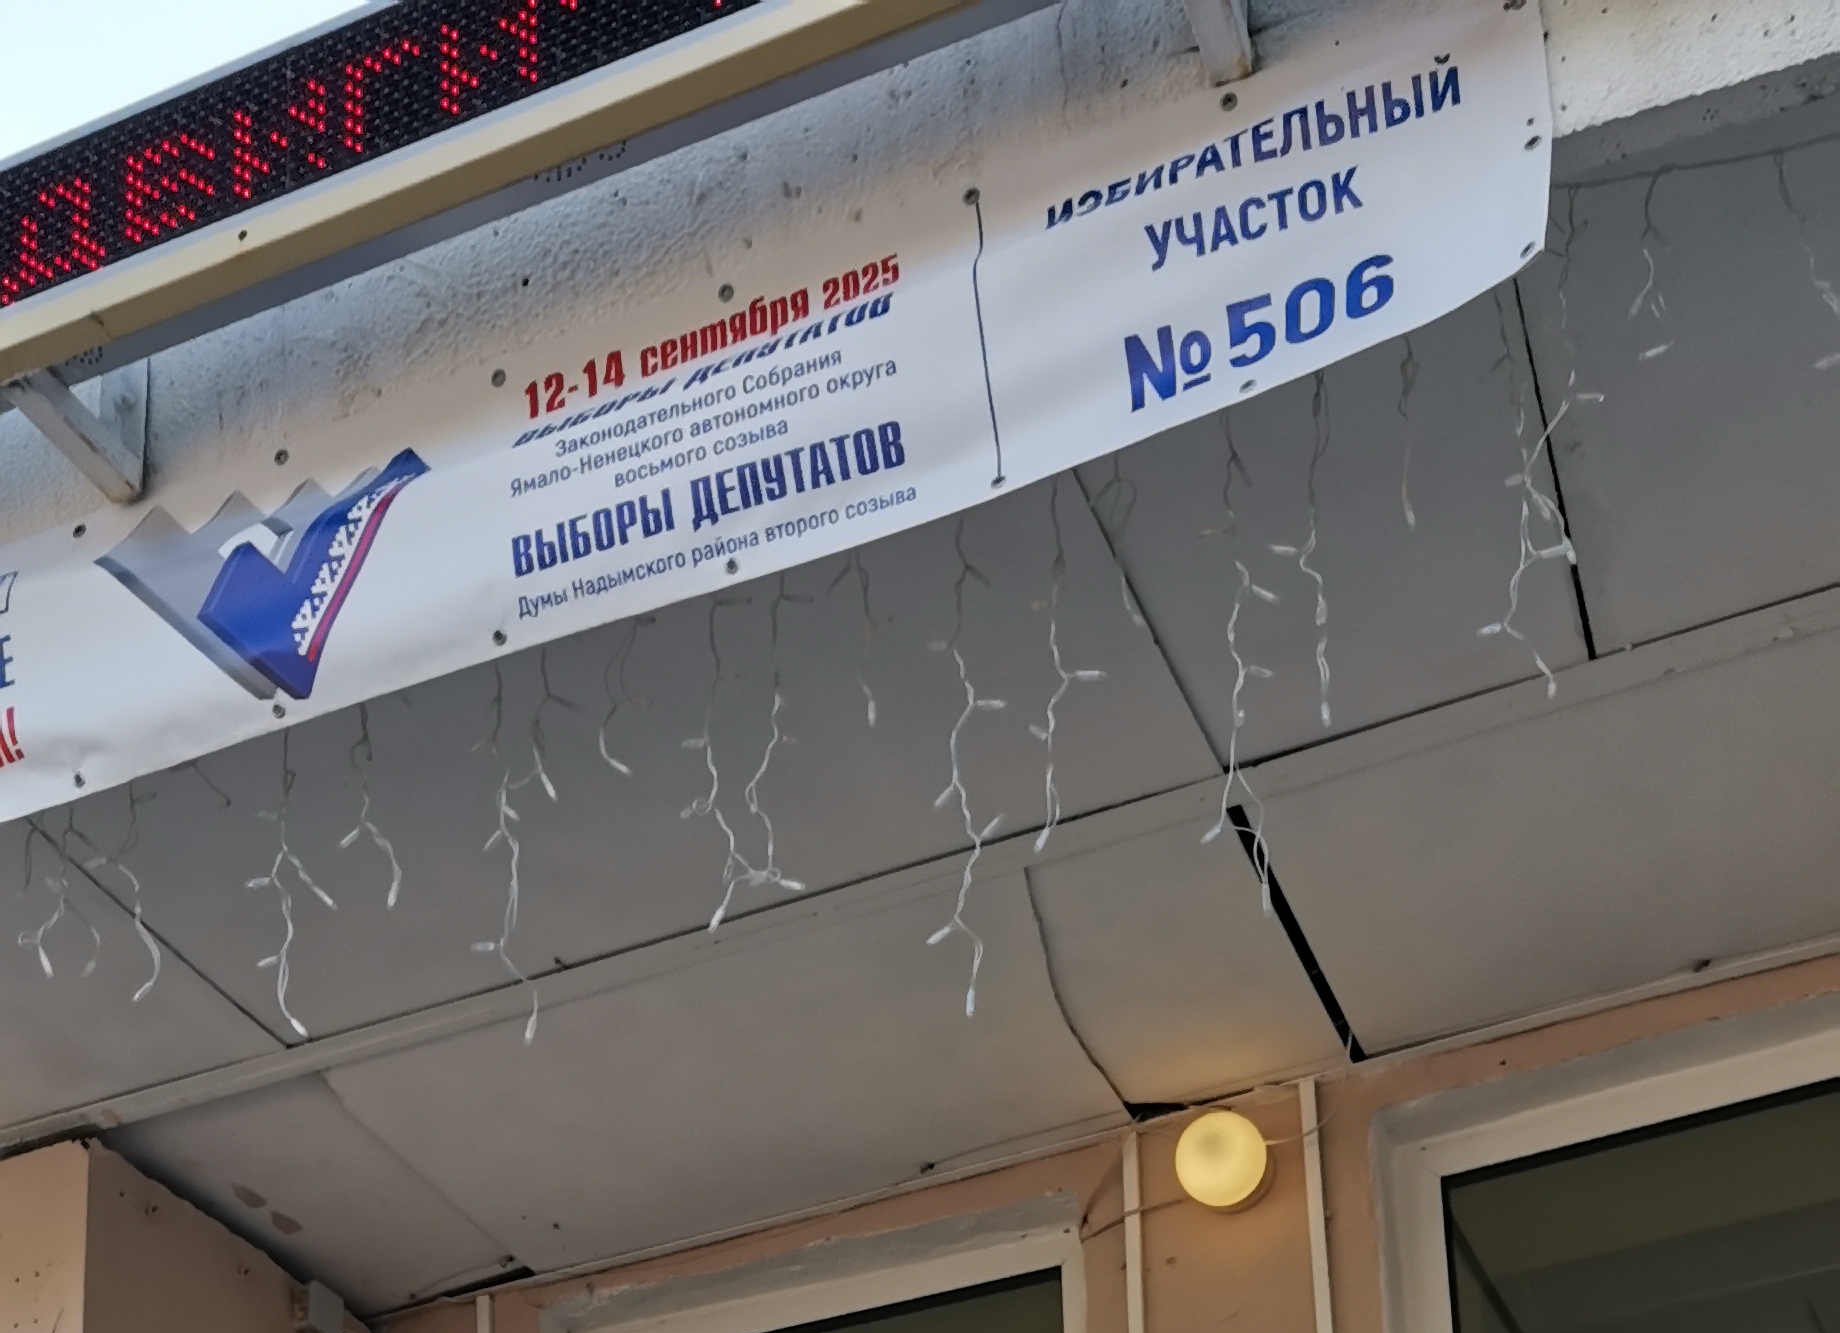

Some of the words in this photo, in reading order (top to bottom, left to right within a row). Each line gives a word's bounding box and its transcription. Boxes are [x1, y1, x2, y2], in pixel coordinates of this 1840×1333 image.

[1045, 54, 1462, 229] ИЗБИРАТЕЛЬНЫЙ
[1144, 165, 1363, 272] УЧАСТОК
[525, 351, 625, 419] 12-14
[640, 287, 810, 378] сентября
[823, 253, 899, 310] 2025
[555, 386, 736, 457] Законодательного
[742, 350, 843, 394] Собрания
[510, 427, 684, 497] Ямало-Ненецкого
[690, 384, 819, 438] автономного
[827, 359, 897, 394] округа
[614, 445, 707, 487] восьмого
[712, 419, 789, 458] созыва
[512, 488, 676, 578] ВЫБОРЫ
[690, 420, 906, 532] ДЕПУТАТОВ
[517, 590, 569, 619] Думы
[572, 553, 686, 600] Надымского
[692, 530, 760, 568] района
[765, 507, 839, 543] второго
[844, 485, 918, 520] созыва
